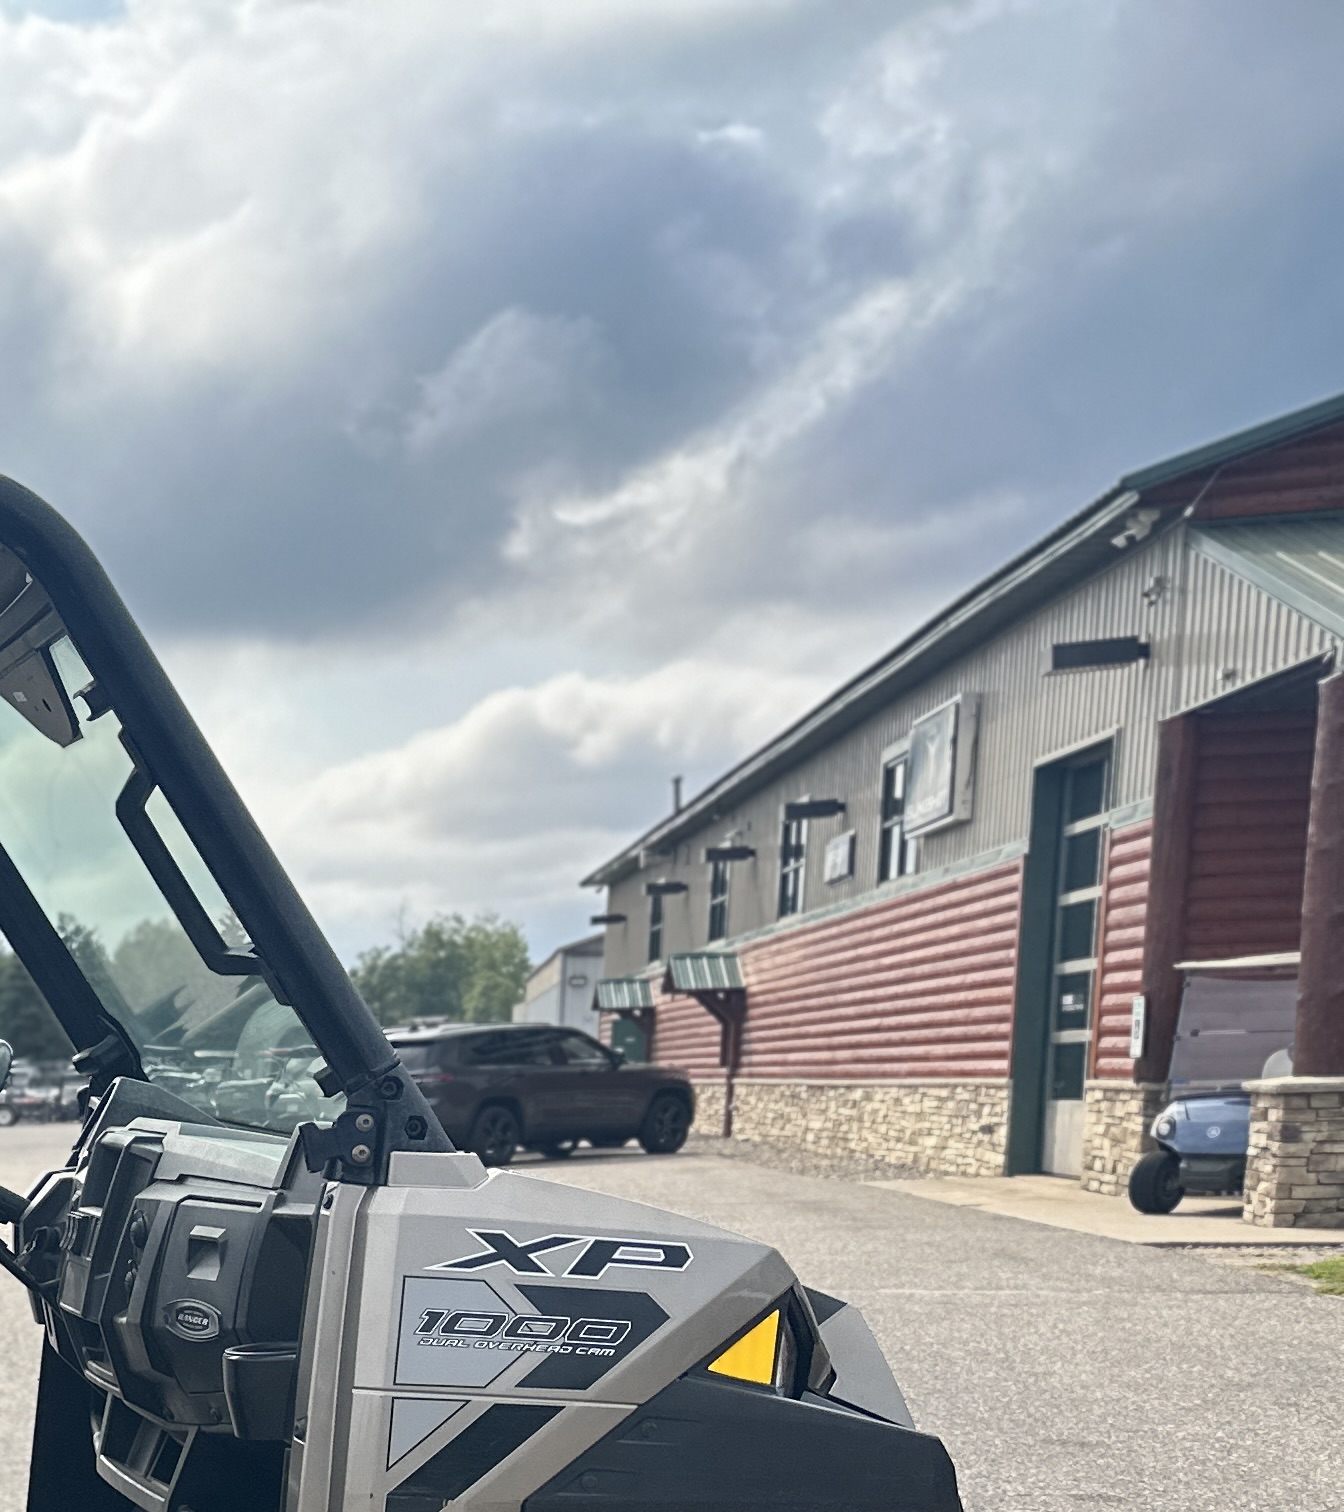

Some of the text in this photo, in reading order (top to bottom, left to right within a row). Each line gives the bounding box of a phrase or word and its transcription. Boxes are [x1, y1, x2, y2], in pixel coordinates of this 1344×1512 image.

[424, 1228, 695, 1280] XP
[178, 1313, 209, 1326] RANGER
[413, 1308, 632, 1346] 1000
[418, 1337, 616, 1357] DUAL OVERHEAD CAM
